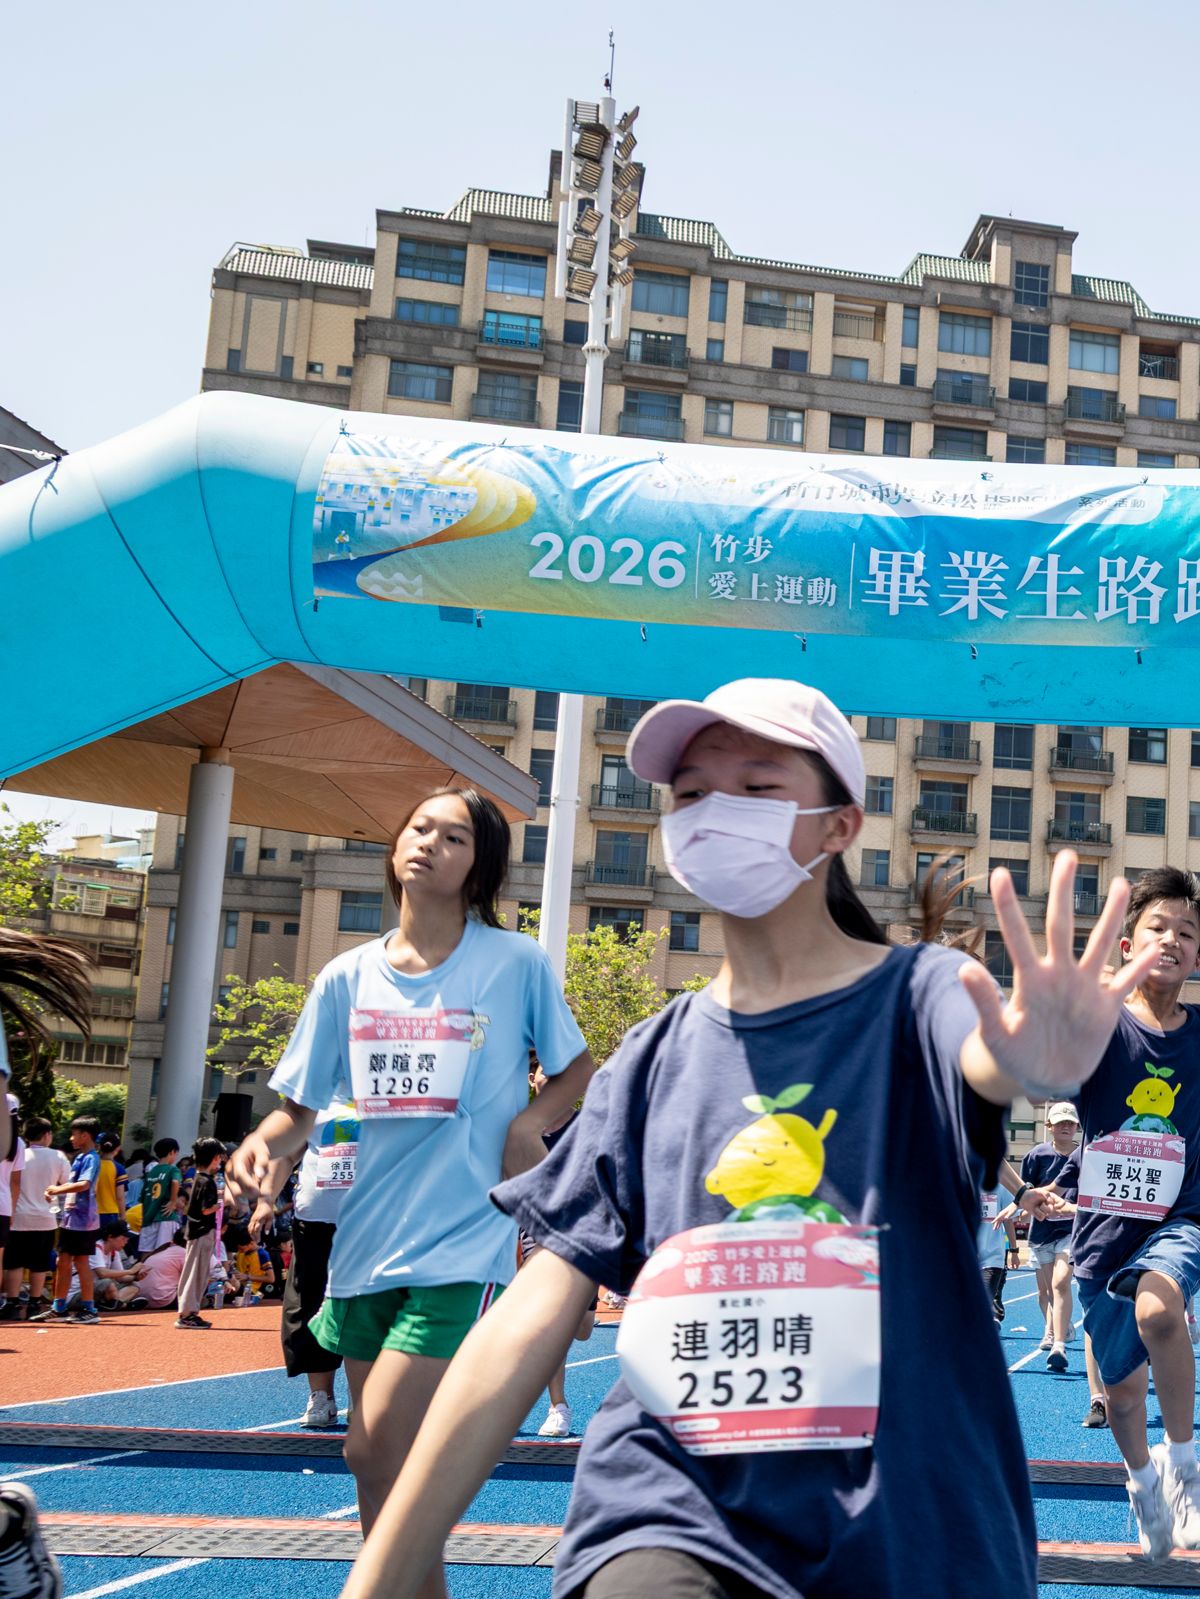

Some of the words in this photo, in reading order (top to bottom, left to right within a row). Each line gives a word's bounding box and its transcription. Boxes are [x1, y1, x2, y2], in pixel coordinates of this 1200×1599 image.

[528, 531, 687, 588] 2026
[710, 534, 774, 564] 竹步
[708, 571, 838, 607] 愛上運動
[370, 1077, 430, 1095] 1296
[330, 1161, 356, 1171] 徐百
[332, 1171, 354, 1180] 255
[1106, 1163, 1162, 1185] 張以聖
[1106, 1183, 1157, 1202] 2516
[684, 1249, 718, 1264] 2026
[684, 1261, 807, 1289] 畢業生路跑
[671, 1314, 814, 1362] 連羽晴
[678, 1366, 804, 1409] 2523
